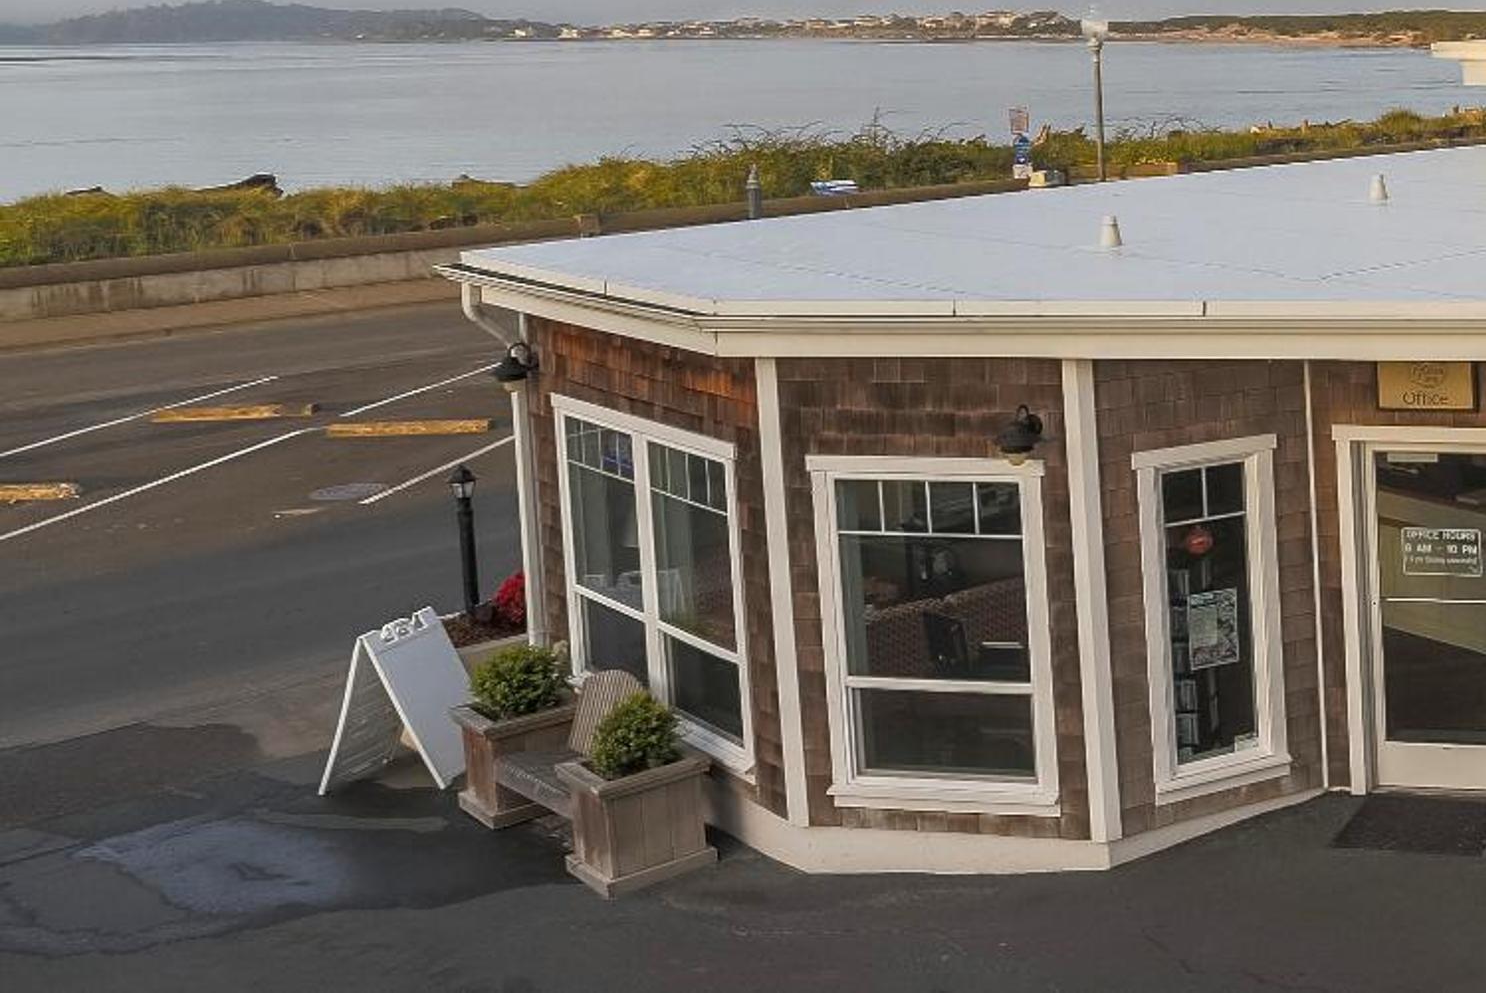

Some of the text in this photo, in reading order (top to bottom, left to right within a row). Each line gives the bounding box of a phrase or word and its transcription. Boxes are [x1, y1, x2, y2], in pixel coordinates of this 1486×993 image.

[1402, 391, 1449, 406] Office
[1442, 531, 1476, 541] HOURS
[1416, 543, 1432, 553] AM
[1462, 544, 1478, 555] PM
